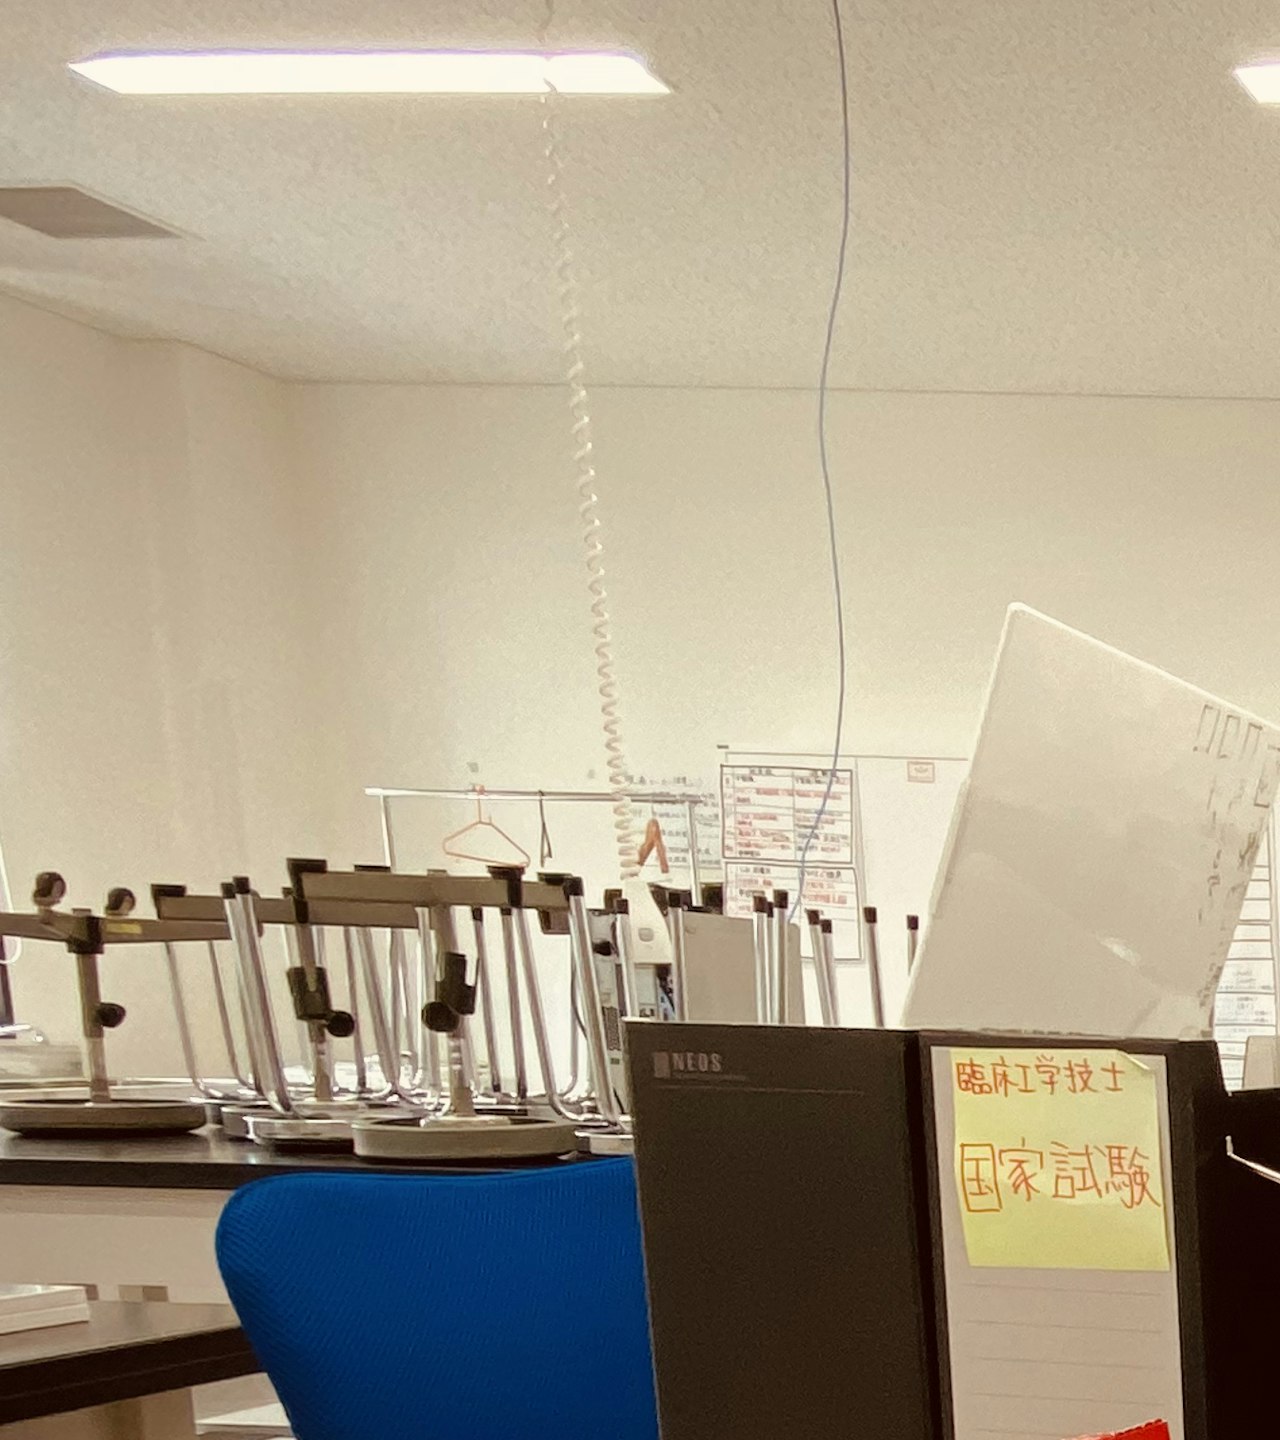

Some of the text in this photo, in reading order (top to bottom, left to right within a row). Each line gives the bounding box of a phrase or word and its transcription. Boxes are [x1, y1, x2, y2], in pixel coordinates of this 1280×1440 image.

[673, 1052, 722, 1072] NEOS
[955, 1055, 1126, 1097] 臨床工学技士
[959, 1137, 1161, 1213] 国家試験
